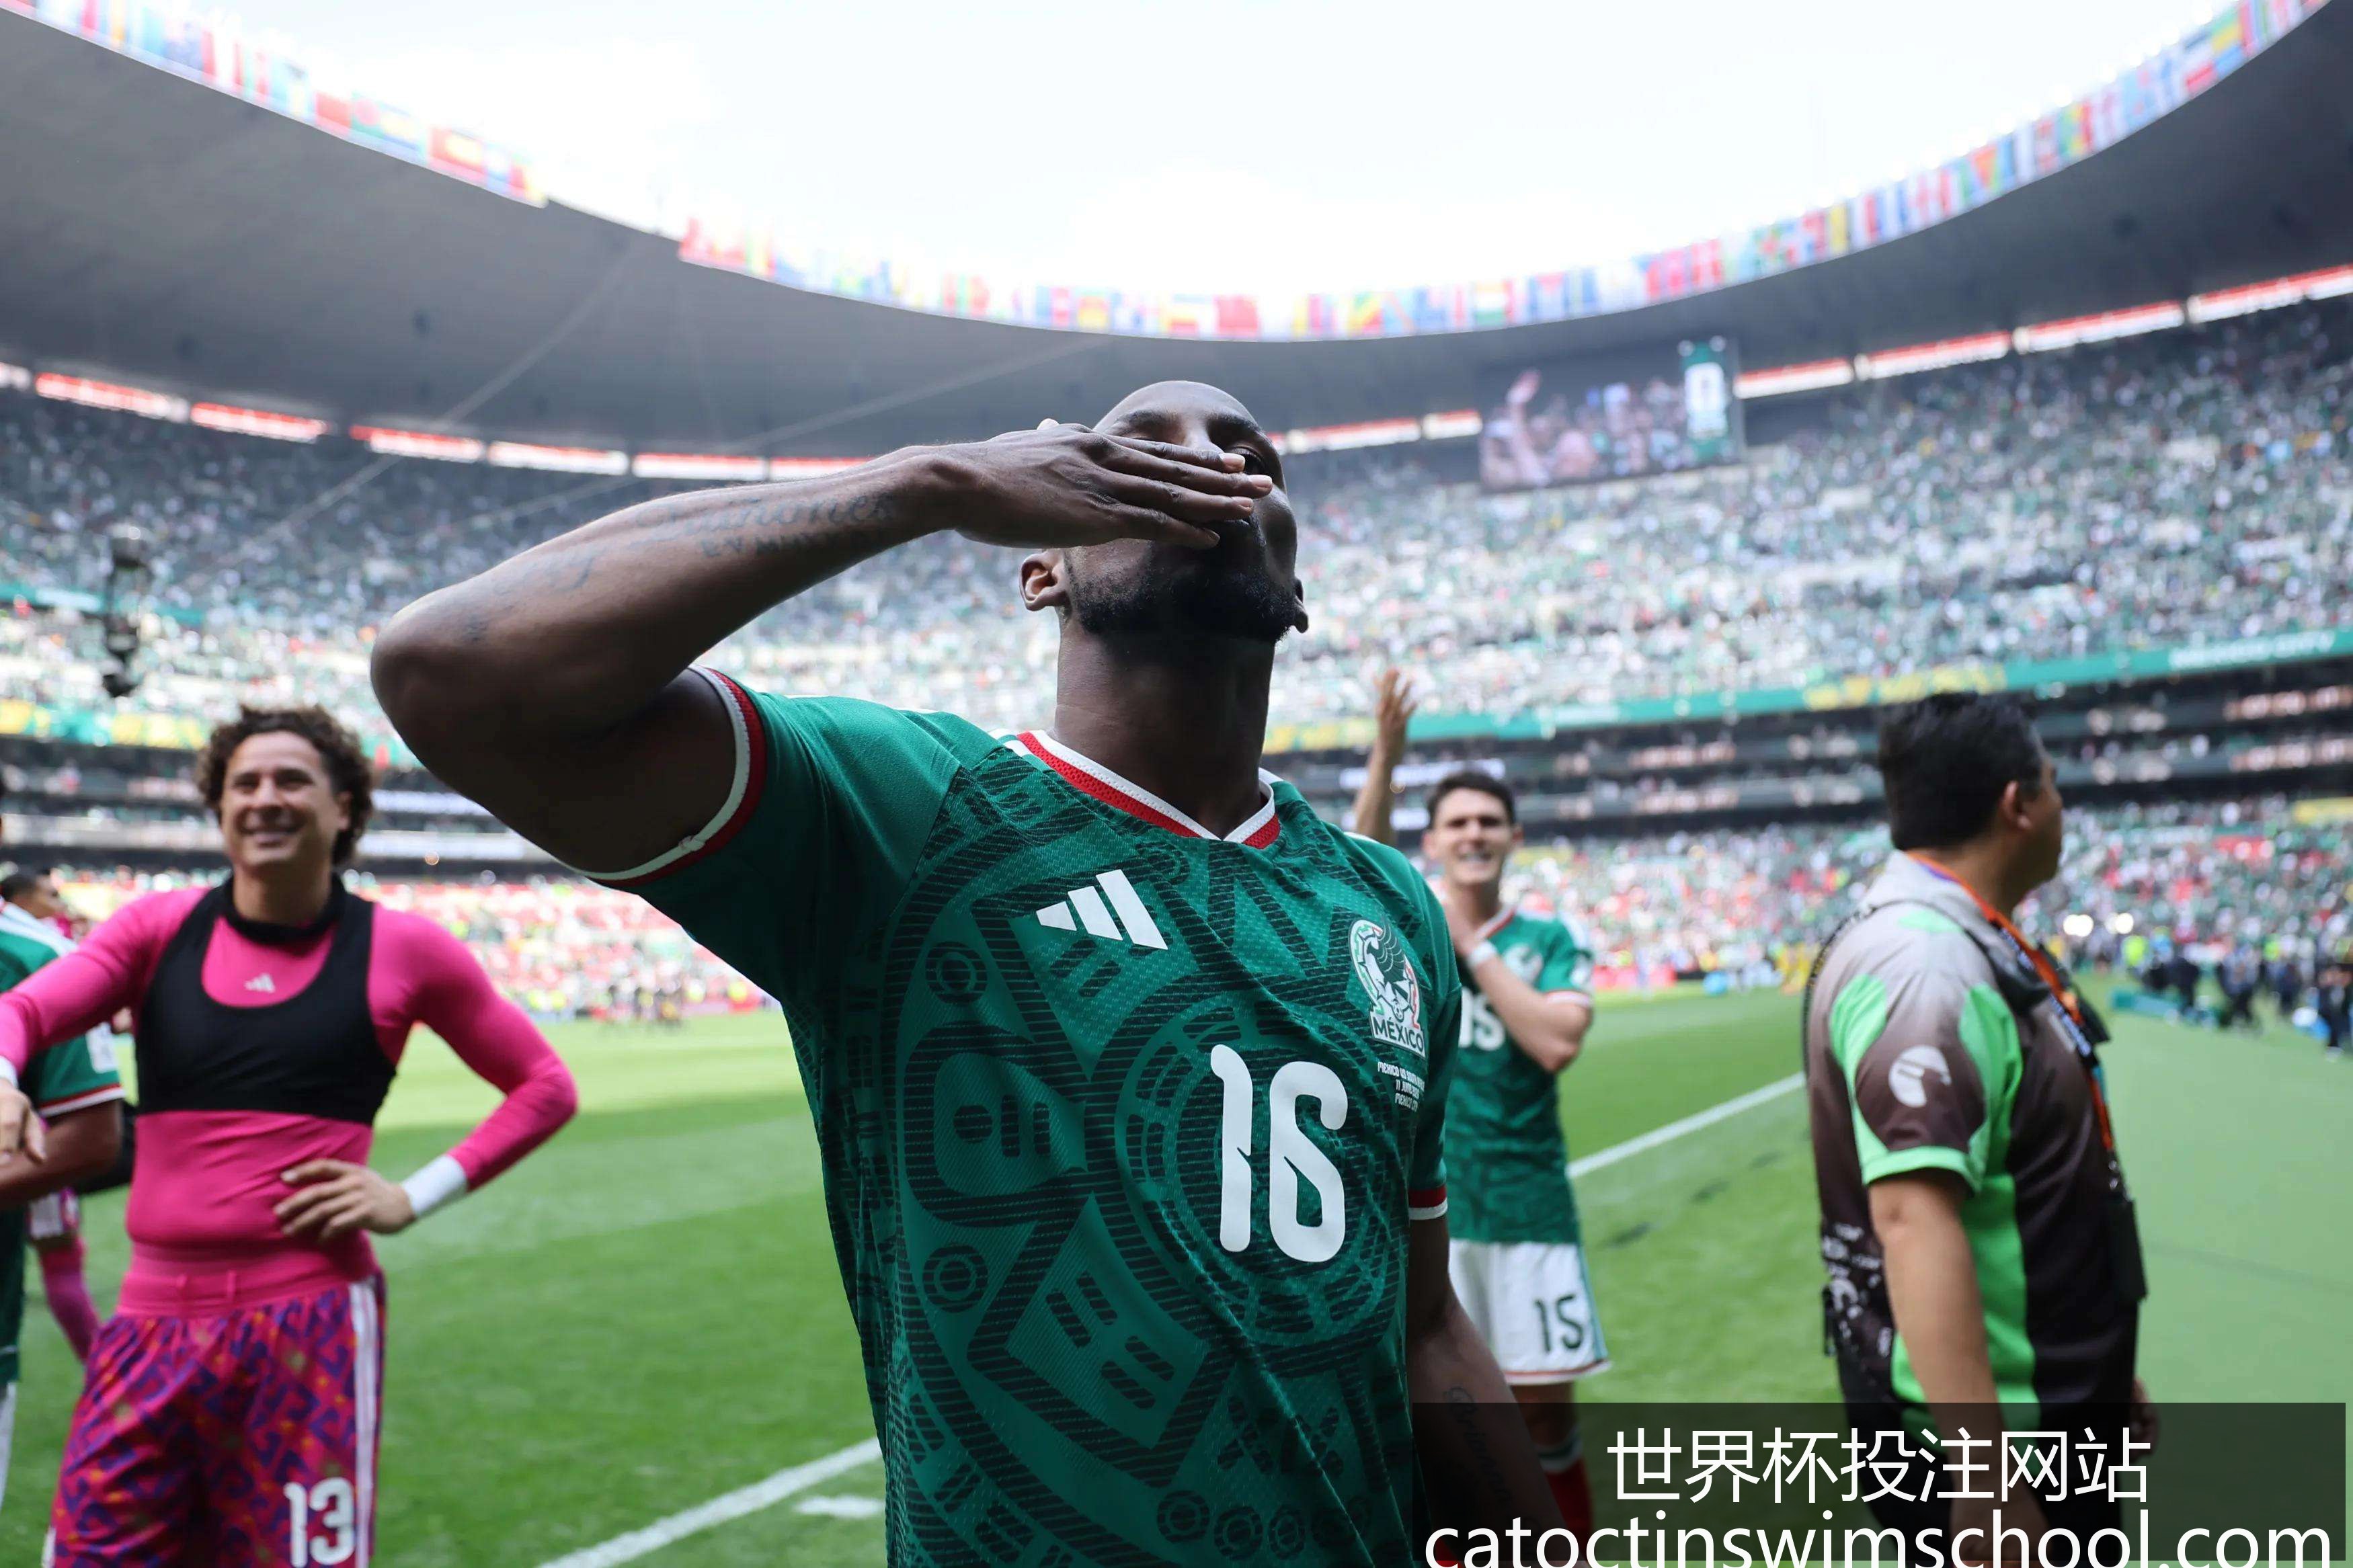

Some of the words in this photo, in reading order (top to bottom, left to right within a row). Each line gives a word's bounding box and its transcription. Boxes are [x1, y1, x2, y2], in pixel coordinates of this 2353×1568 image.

[1373, 1016, 1424, 1053] MÉXICO
[1458, 986, 1505, 1050] 15
[1378, 1061, 1399, 1077] MEXICO
[1211, 1044, 1347, 1262] 16
[1533, 1294, 1584, 1353] 15
[283, 1477, 355, 1568] 13
